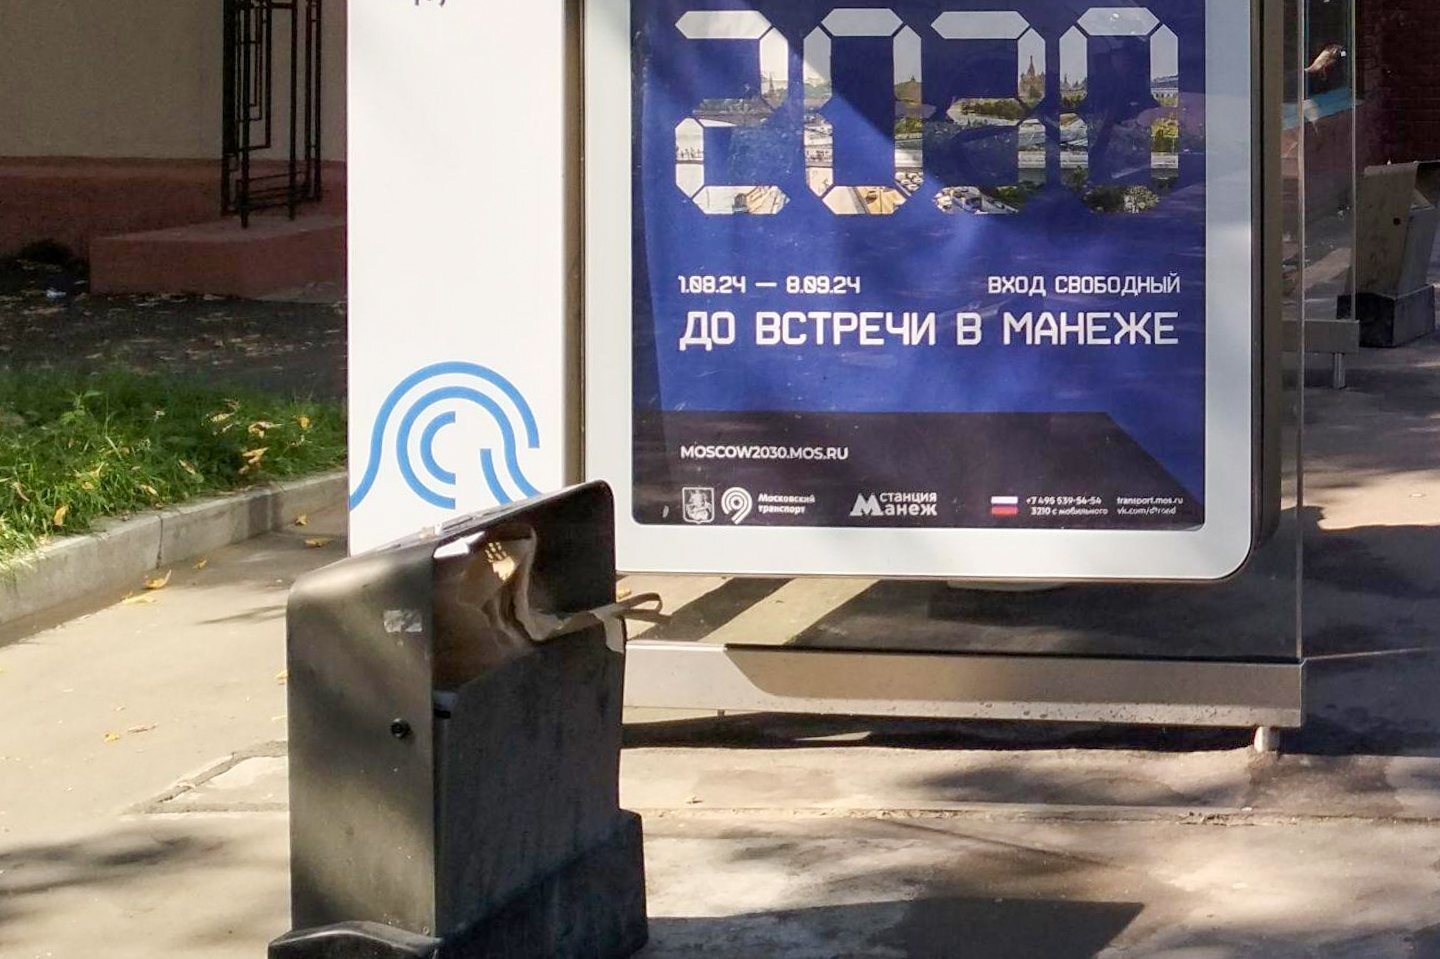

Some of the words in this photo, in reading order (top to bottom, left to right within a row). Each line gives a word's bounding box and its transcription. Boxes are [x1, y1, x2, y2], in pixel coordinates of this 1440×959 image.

[674, 7, 1180, 216] 2030
[677, 275, 747, 295] 1.08.24
[786, 275, 861, 295] 8.09.24
[987, 276, 1047, 297] ВХОД
[1054, 272, 1181, 296] СВОБОДНЫЙ
[679, 311, 736, 351] ДО
[756, 311, 936, 346] ВСТРЕЧИ
[957, 312, 982, 346] В
[1004, 312, 1179, 346] МАНЕЖЕ
[680, 445, 849, 460] MOSCOW2030.MOS.RU
[758, 492, 816, 504] Московский
[849, 493, 938, 517] Манеж
[880, 491, 937, 503] станция
[758, 505, 806, 514] транспорт
